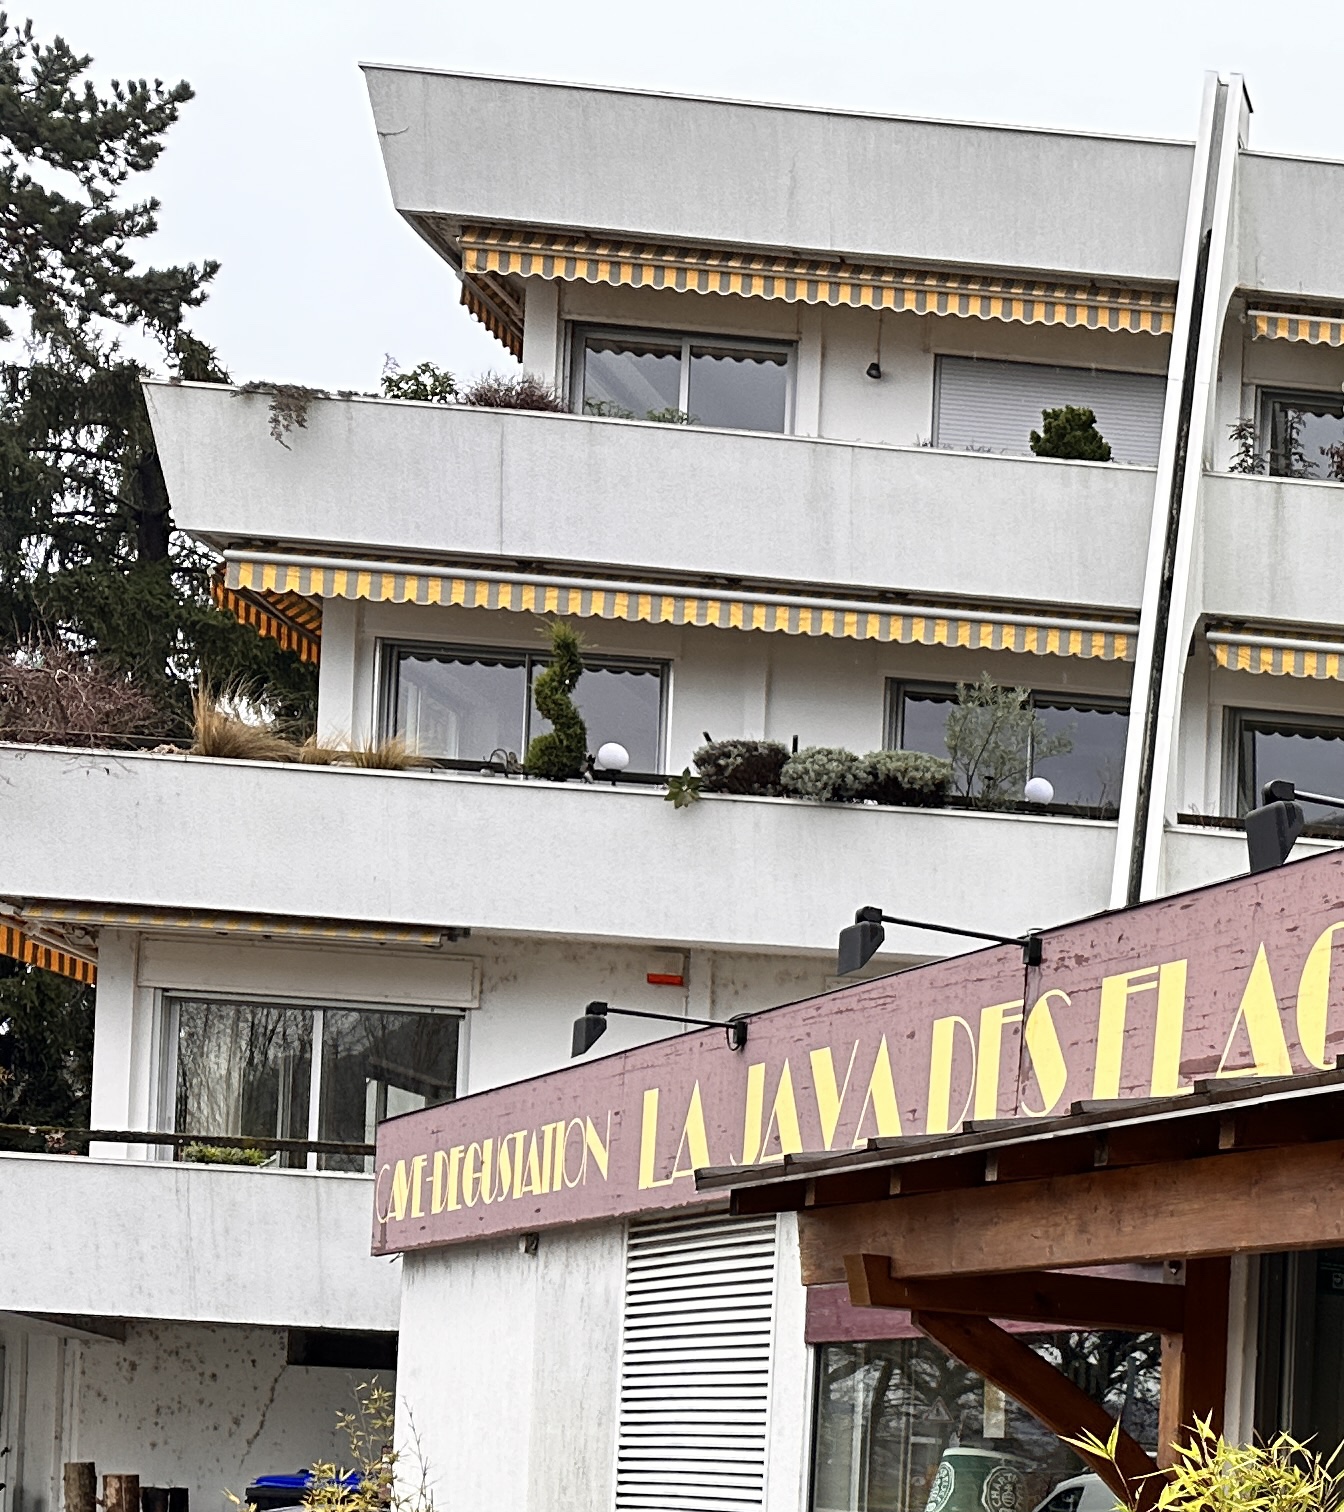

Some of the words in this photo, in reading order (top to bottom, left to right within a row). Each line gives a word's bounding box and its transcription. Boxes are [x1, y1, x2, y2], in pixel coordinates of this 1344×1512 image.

[638, 1078, 711, 1190] LA
[728, 1032, 903, 1166] JAVA
[925, 988, 1072, 1135] DES
